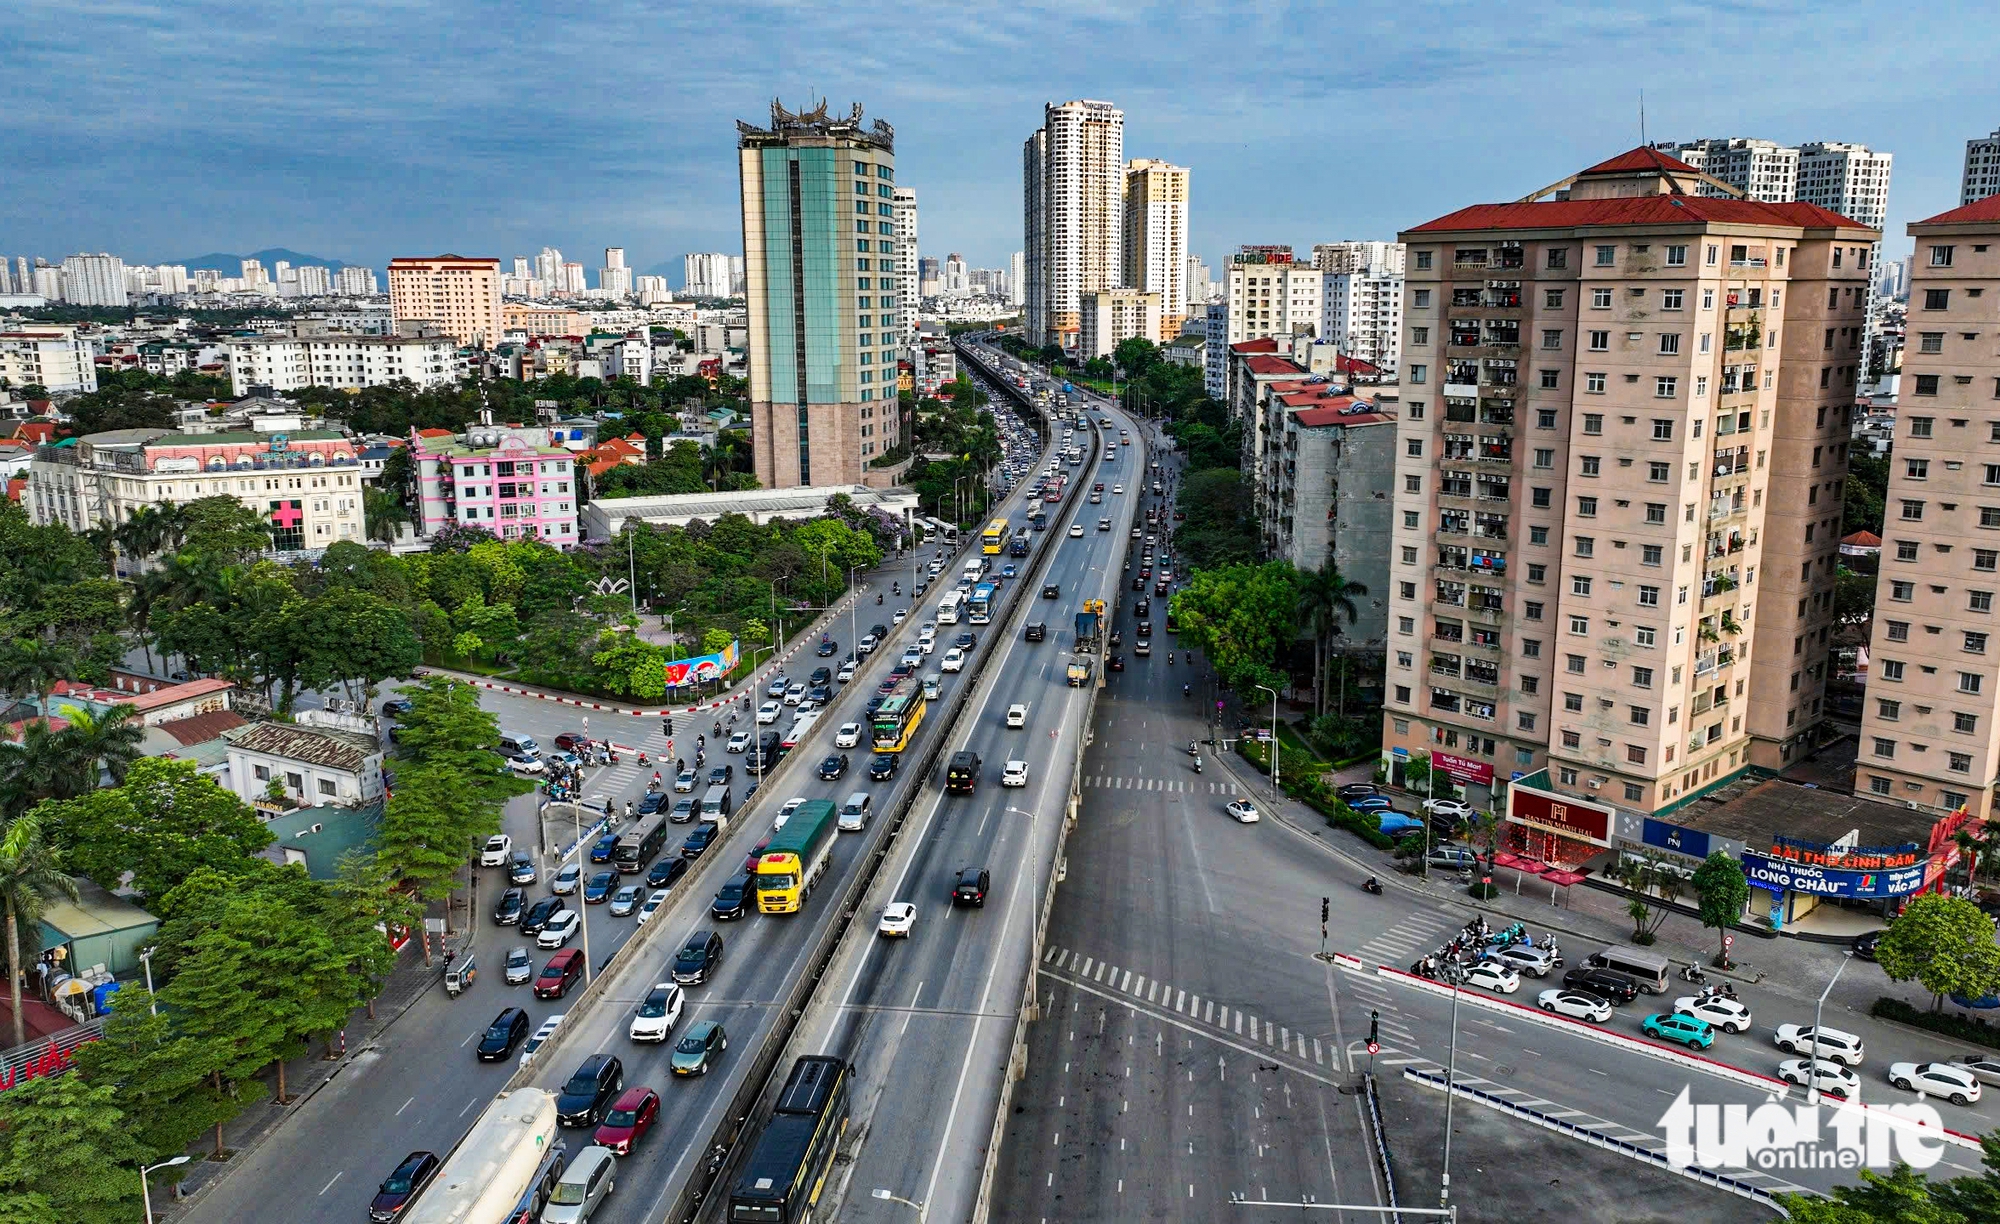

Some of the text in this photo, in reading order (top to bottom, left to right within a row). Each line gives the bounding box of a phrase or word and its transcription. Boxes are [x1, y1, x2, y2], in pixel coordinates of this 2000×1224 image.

[1657, 141, 1676, 150] MHDI
[282, 450, 309, 459] HOPE
[1466, 761, 1482, 771] Mart
[1667, 837, 1681, 848] PNJ
[1843, 855, 1881, 867] LINH
[1767, 861, 1823, 878] NHÀ THUỐC
[1750, 866, 1838, 893] LONG CHÂU
[1888, 877, 1921, 893] VẮC XIN
